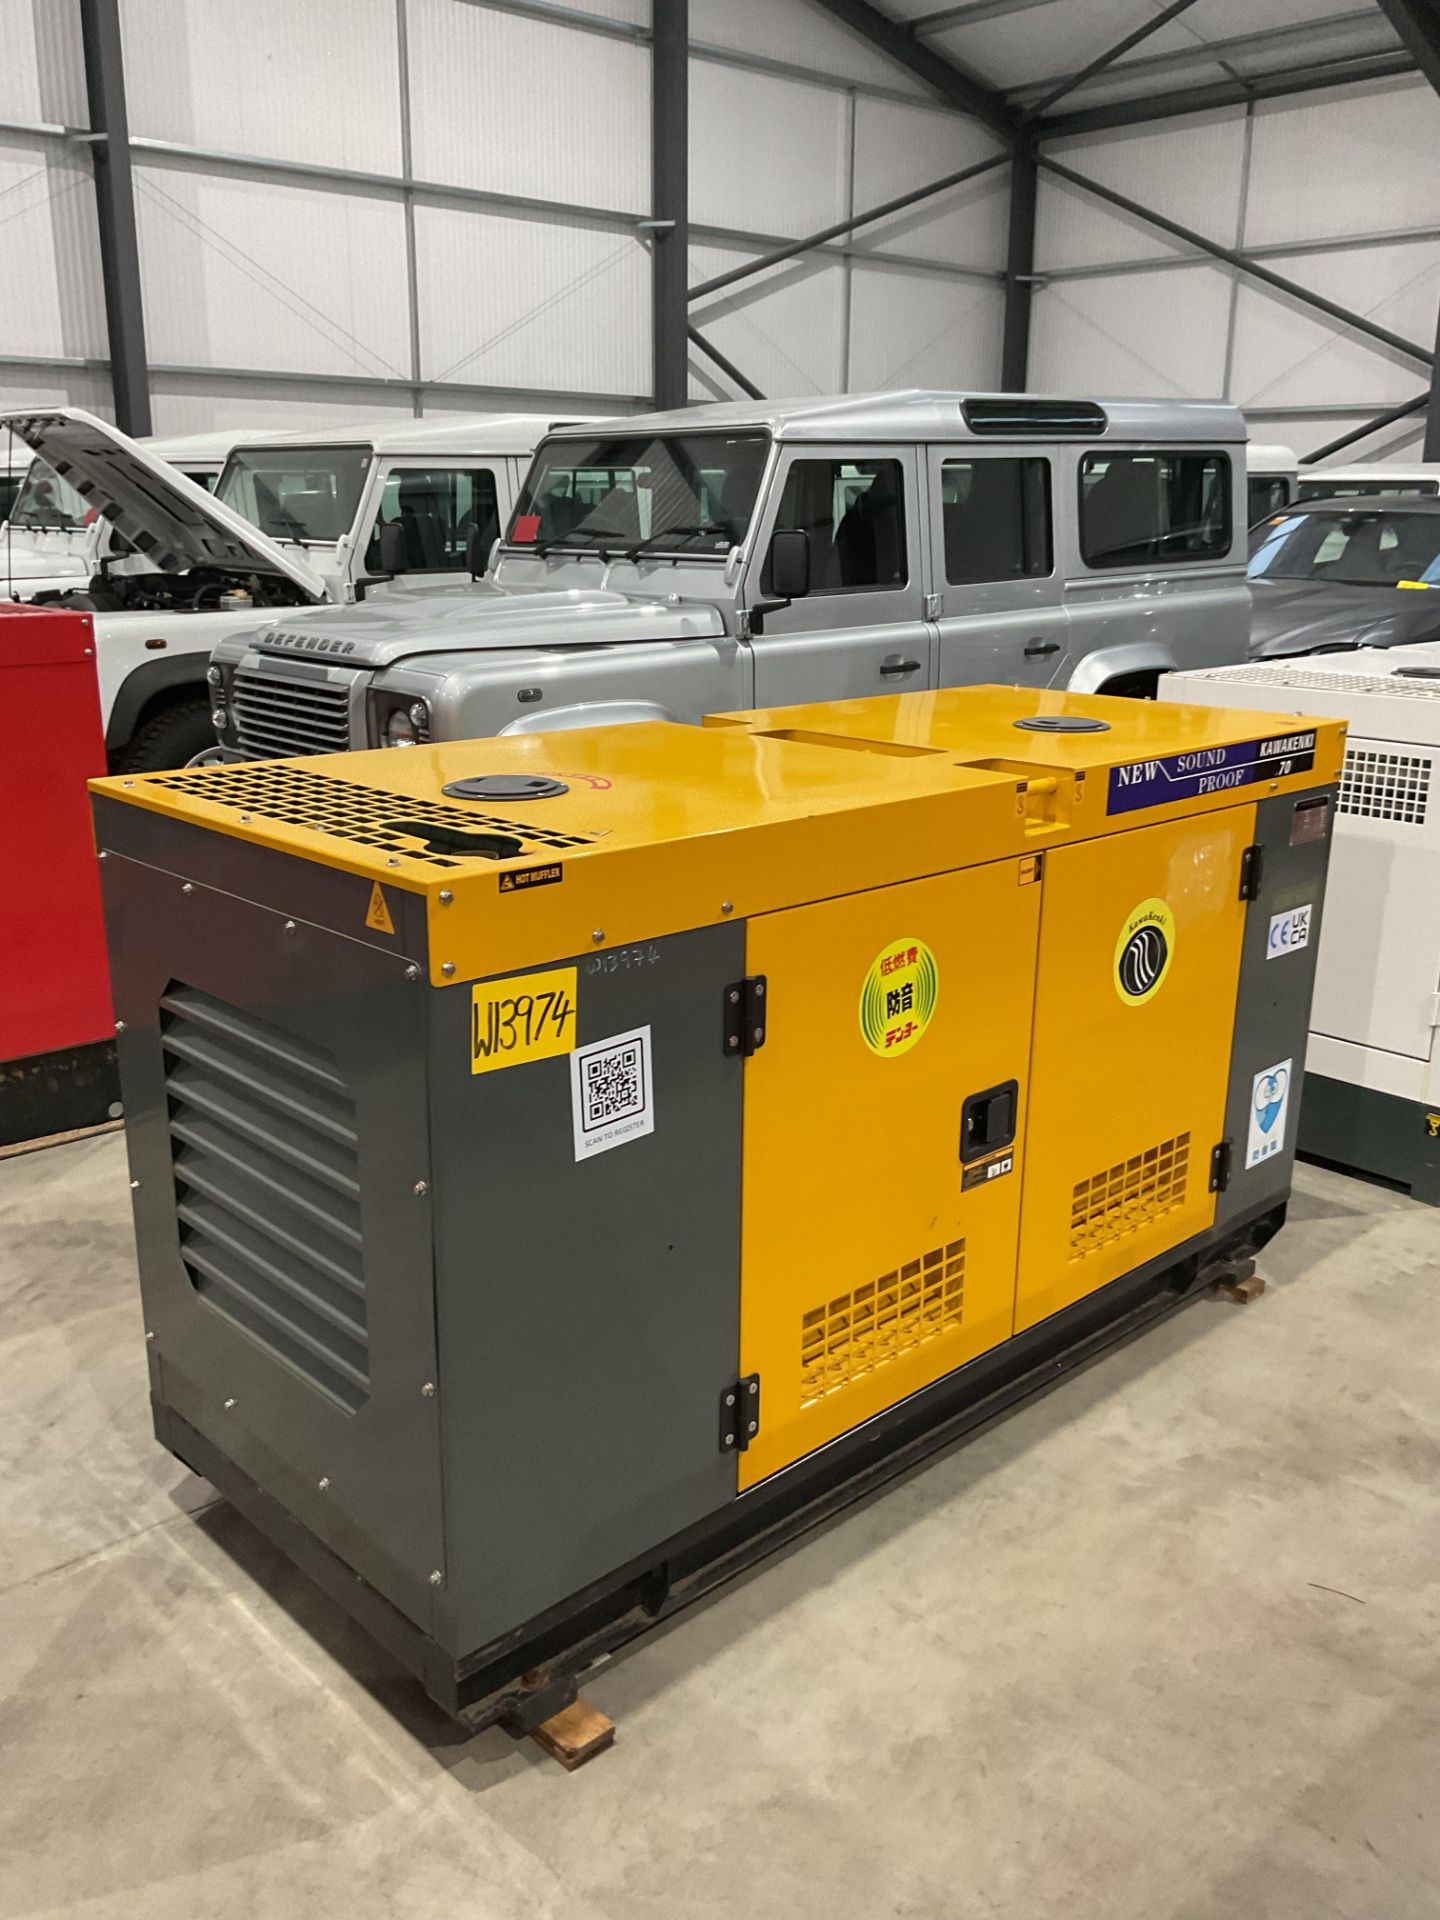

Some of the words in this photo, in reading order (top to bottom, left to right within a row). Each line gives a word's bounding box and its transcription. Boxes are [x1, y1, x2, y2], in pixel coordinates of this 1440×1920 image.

[263, 631, 356, 655] DEFENDER
[1259, 733, 1314, 758] KAWAKENKI
[1117, 761, 1160, 787] NEW
[1176, 748, 1226, 773] SOUND
[1198, 769, 1245, 795] PROOF
[515, 872, 530, 885] HOT
[1292, 911, 1309, 928] UK
[880, 946, 918, 977] 低燃費
[886, 982, 914, 1020] 防音
[584, 1134, 603, 1148] SCAN
[604, 1131, 614, 1141] TO
[614, 1119, 645, 1136] REGISTER
